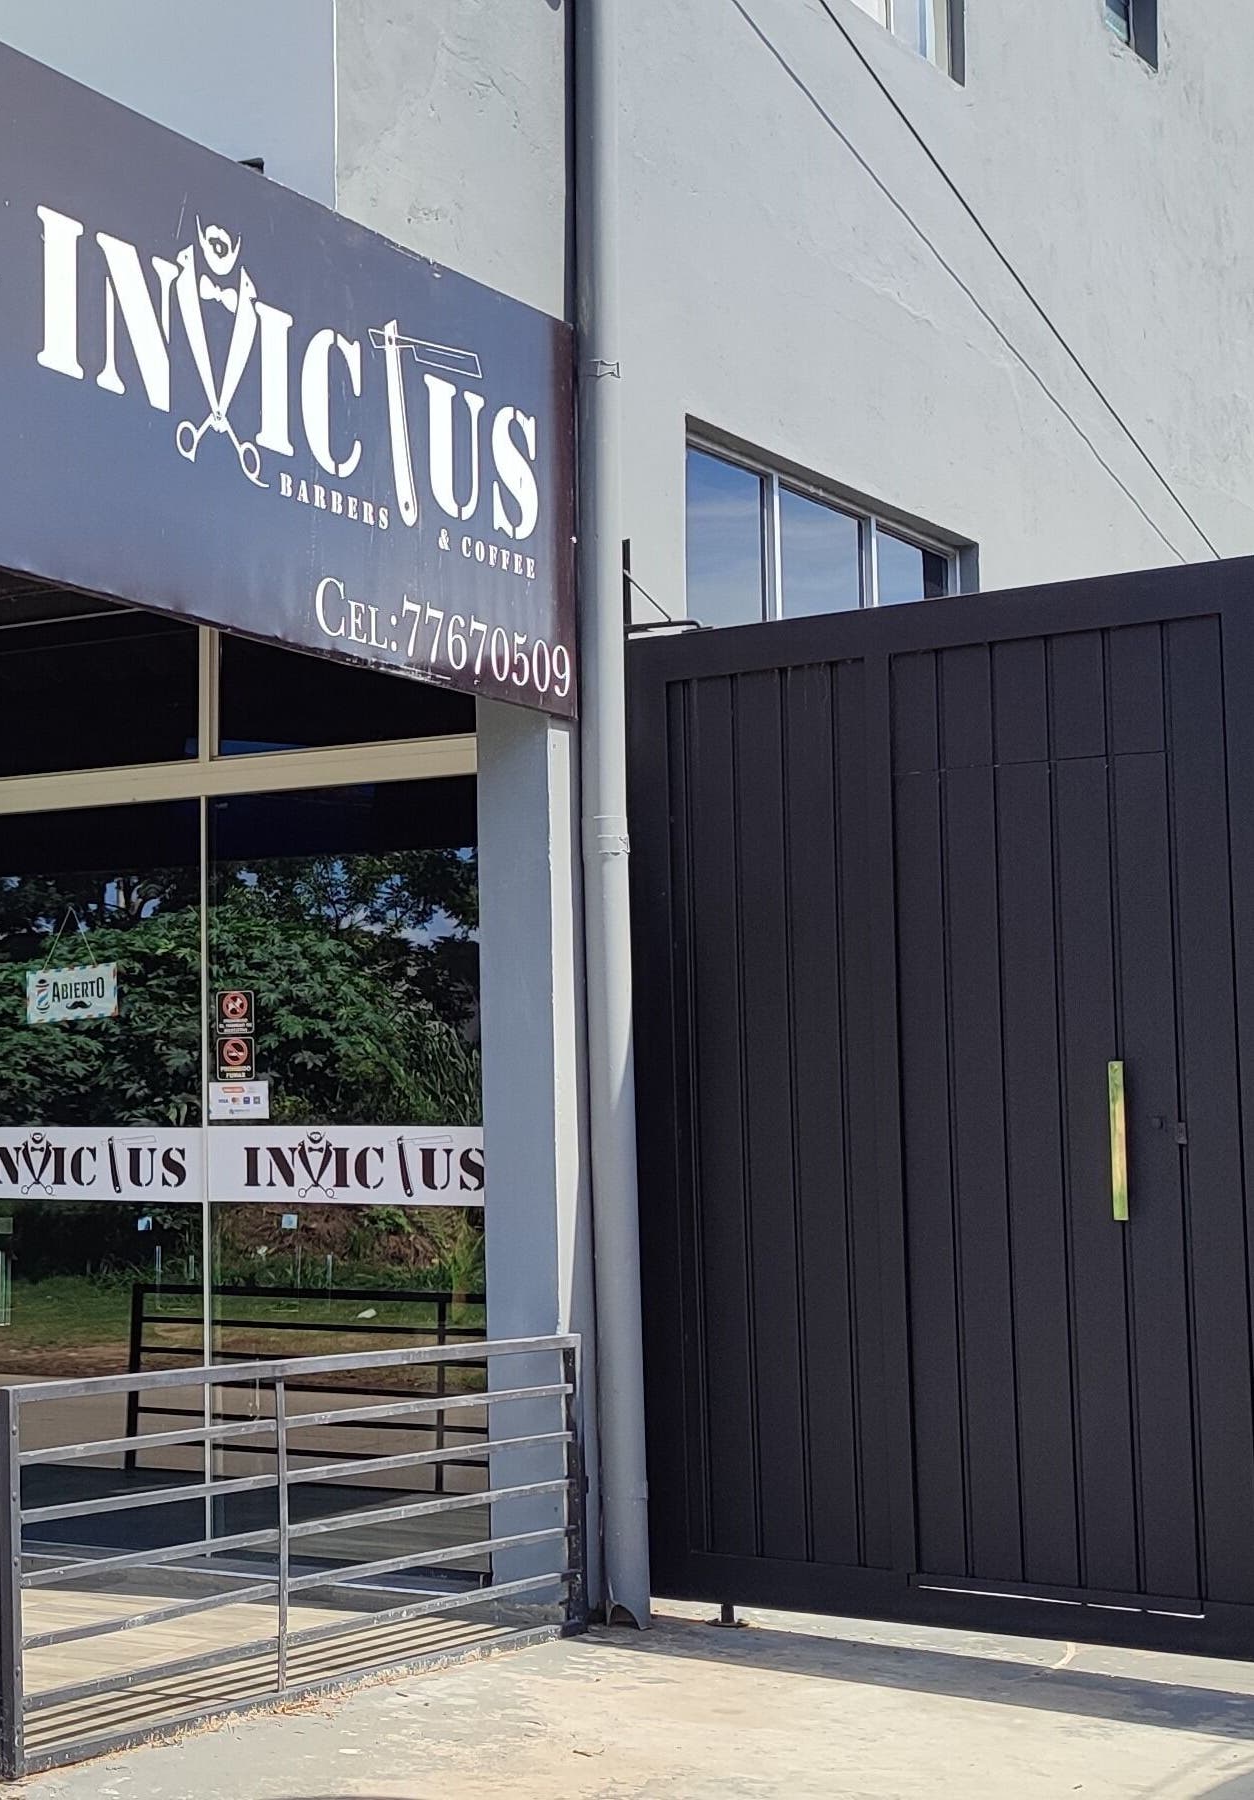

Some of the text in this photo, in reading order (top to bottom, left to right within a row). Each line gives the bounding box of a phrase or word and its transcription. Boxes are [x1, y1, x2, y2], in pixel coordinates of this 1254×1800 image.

[36, 204, 539, 541] INVICTUS
[279, 472, 390, 531] BARBERS
[437, 527, 536, 580] & COFFEE
[52, 977, 105, 1003] ABIERTO
[244, 1130, 485, 1200] INVICTUS
